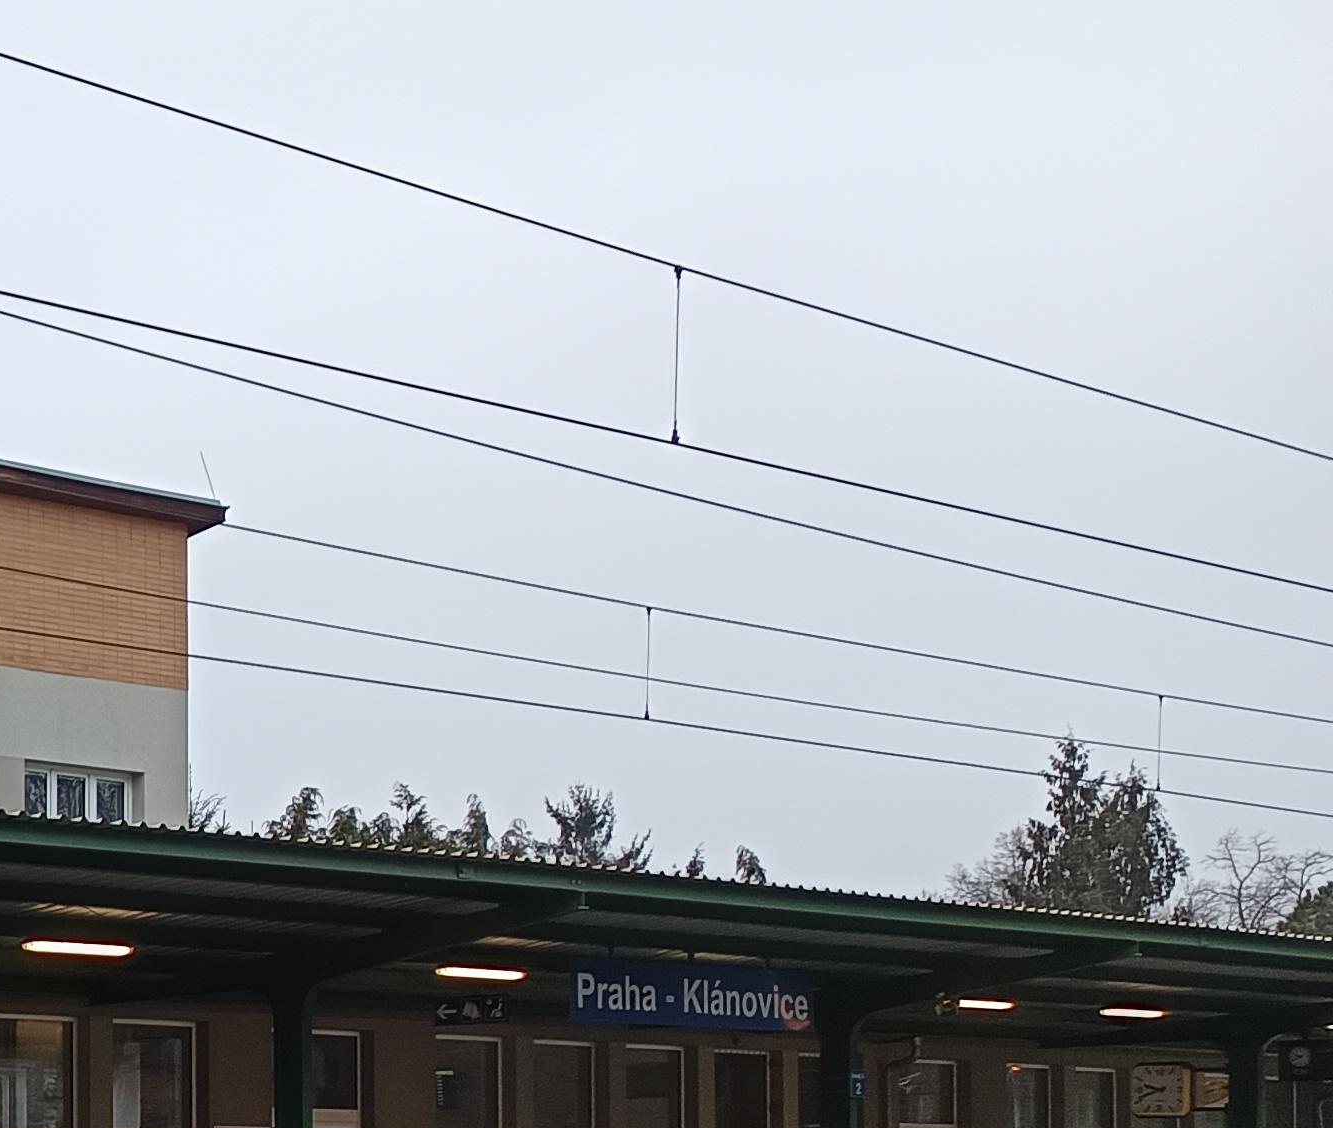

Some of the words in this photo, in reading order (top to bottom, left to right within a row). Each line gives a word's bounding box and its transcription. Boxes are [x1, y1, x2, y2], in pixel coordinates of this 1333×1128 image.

[576, 972, 657, 1012] Praha
[683, 978, 809, 1021] Klánovice
[855, 1082, 862, 1095] 2
